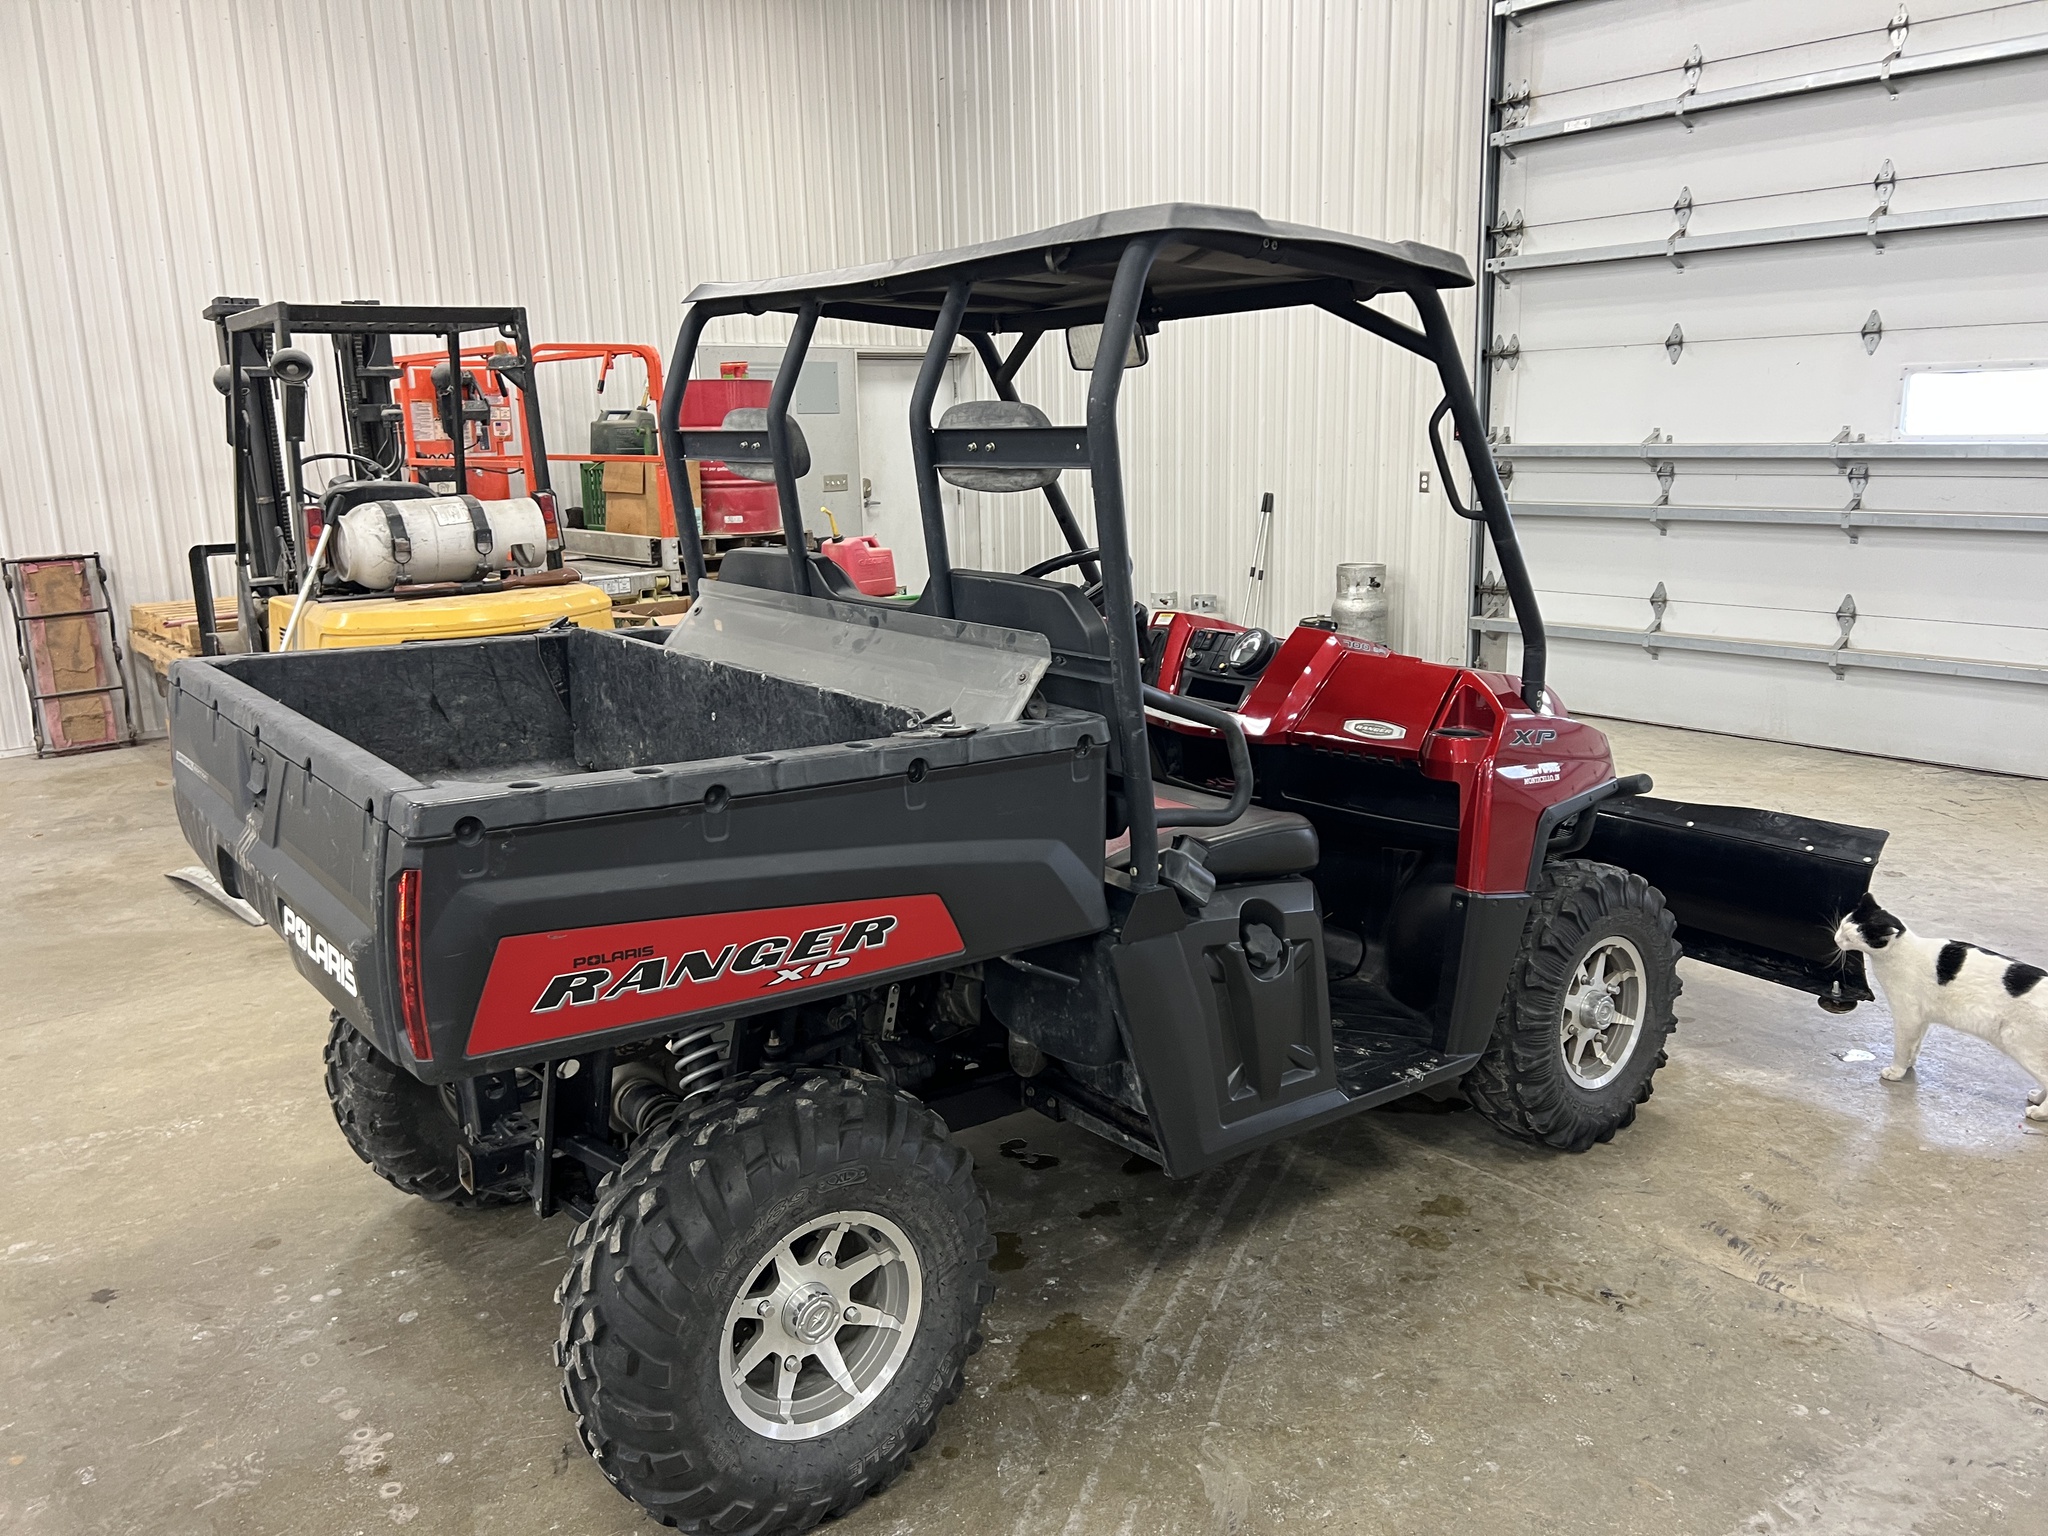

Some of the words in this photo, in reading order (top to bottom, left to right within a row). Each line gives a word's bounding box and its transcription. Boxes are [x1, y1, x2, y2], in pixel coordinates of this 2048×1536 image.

[1344, 640, 1370, 651] 700
[1355, 725, 1392, 734] RANGER
[1509, 729, 1556, 746] XP
[283, 905, 358, 998] POLARIS
[530, 915, 898, 1014] RANGER
[573, 945, 655, 969] POLARIS
[762, 957, 851, 987] XP
[847, 1353, 954, 1482] CARLISLE
